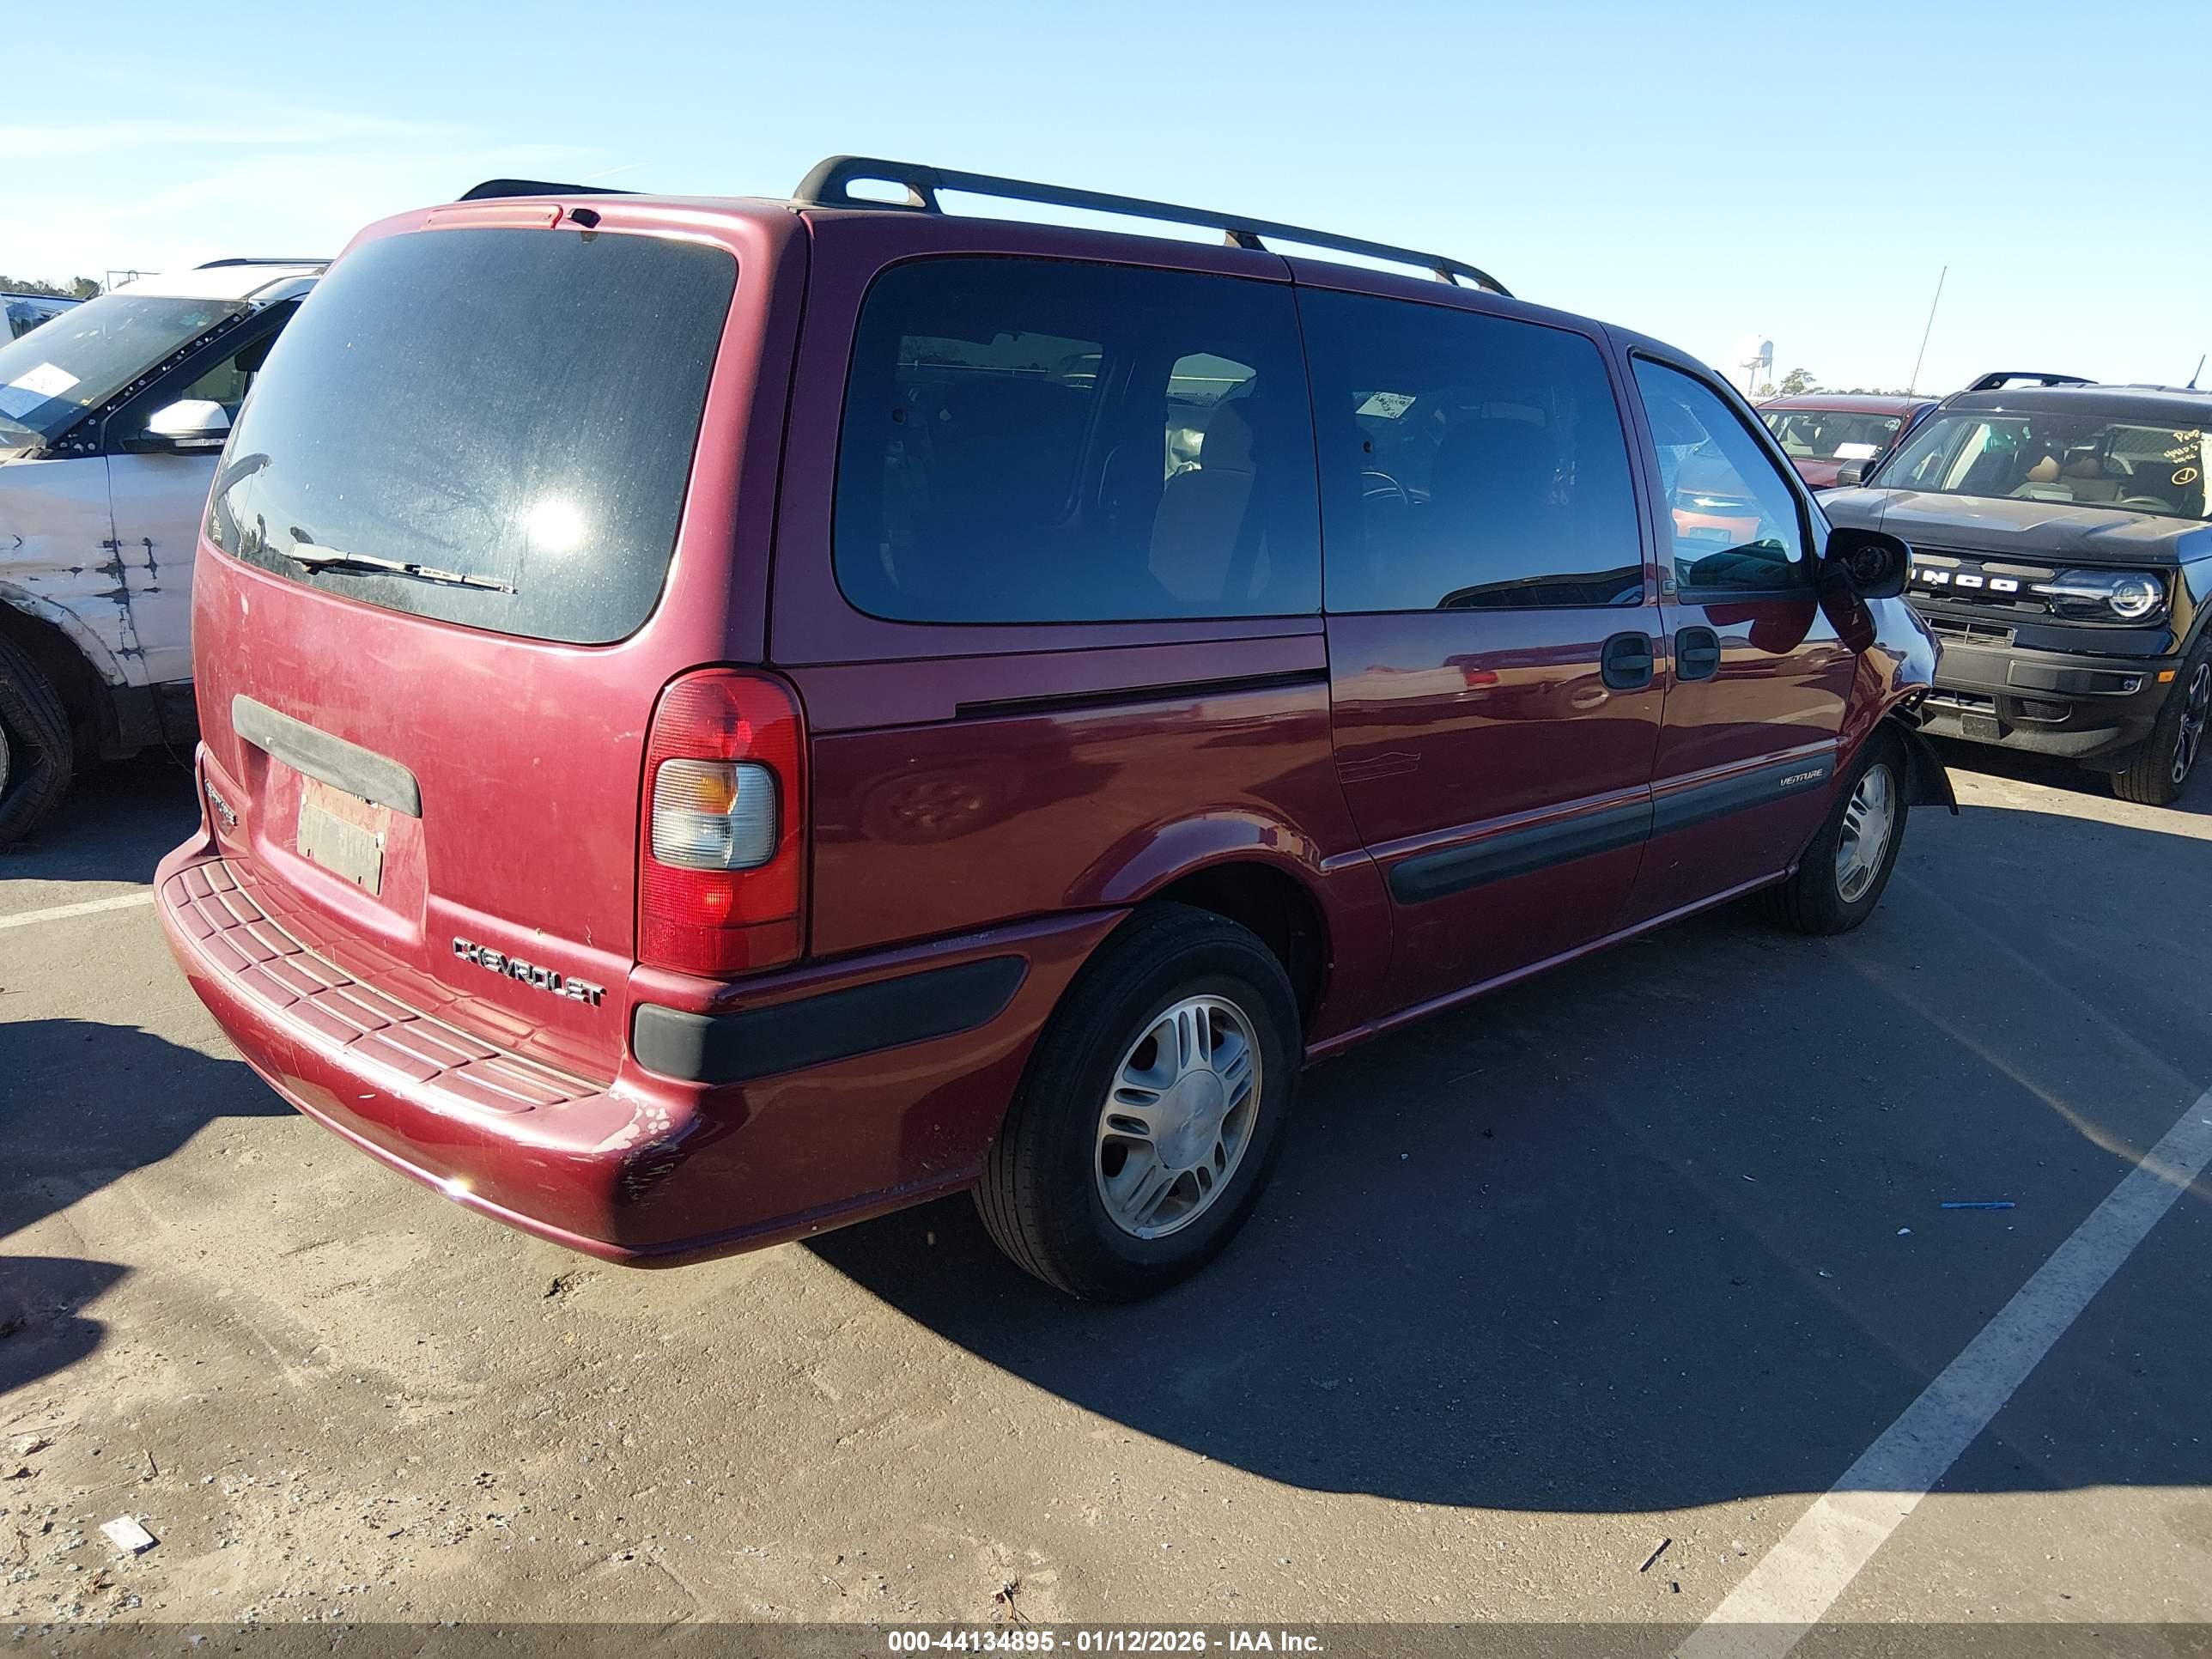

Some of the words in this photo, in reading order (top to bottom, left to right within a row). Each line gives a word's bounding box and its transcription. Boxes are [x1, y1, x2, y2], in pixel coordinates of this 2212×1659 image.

[1911, 568, 2018, 592] NCO
[1780, 769, 1823, 787] VENTURE
[453, 936, 607, 1006] CHEVROLET
